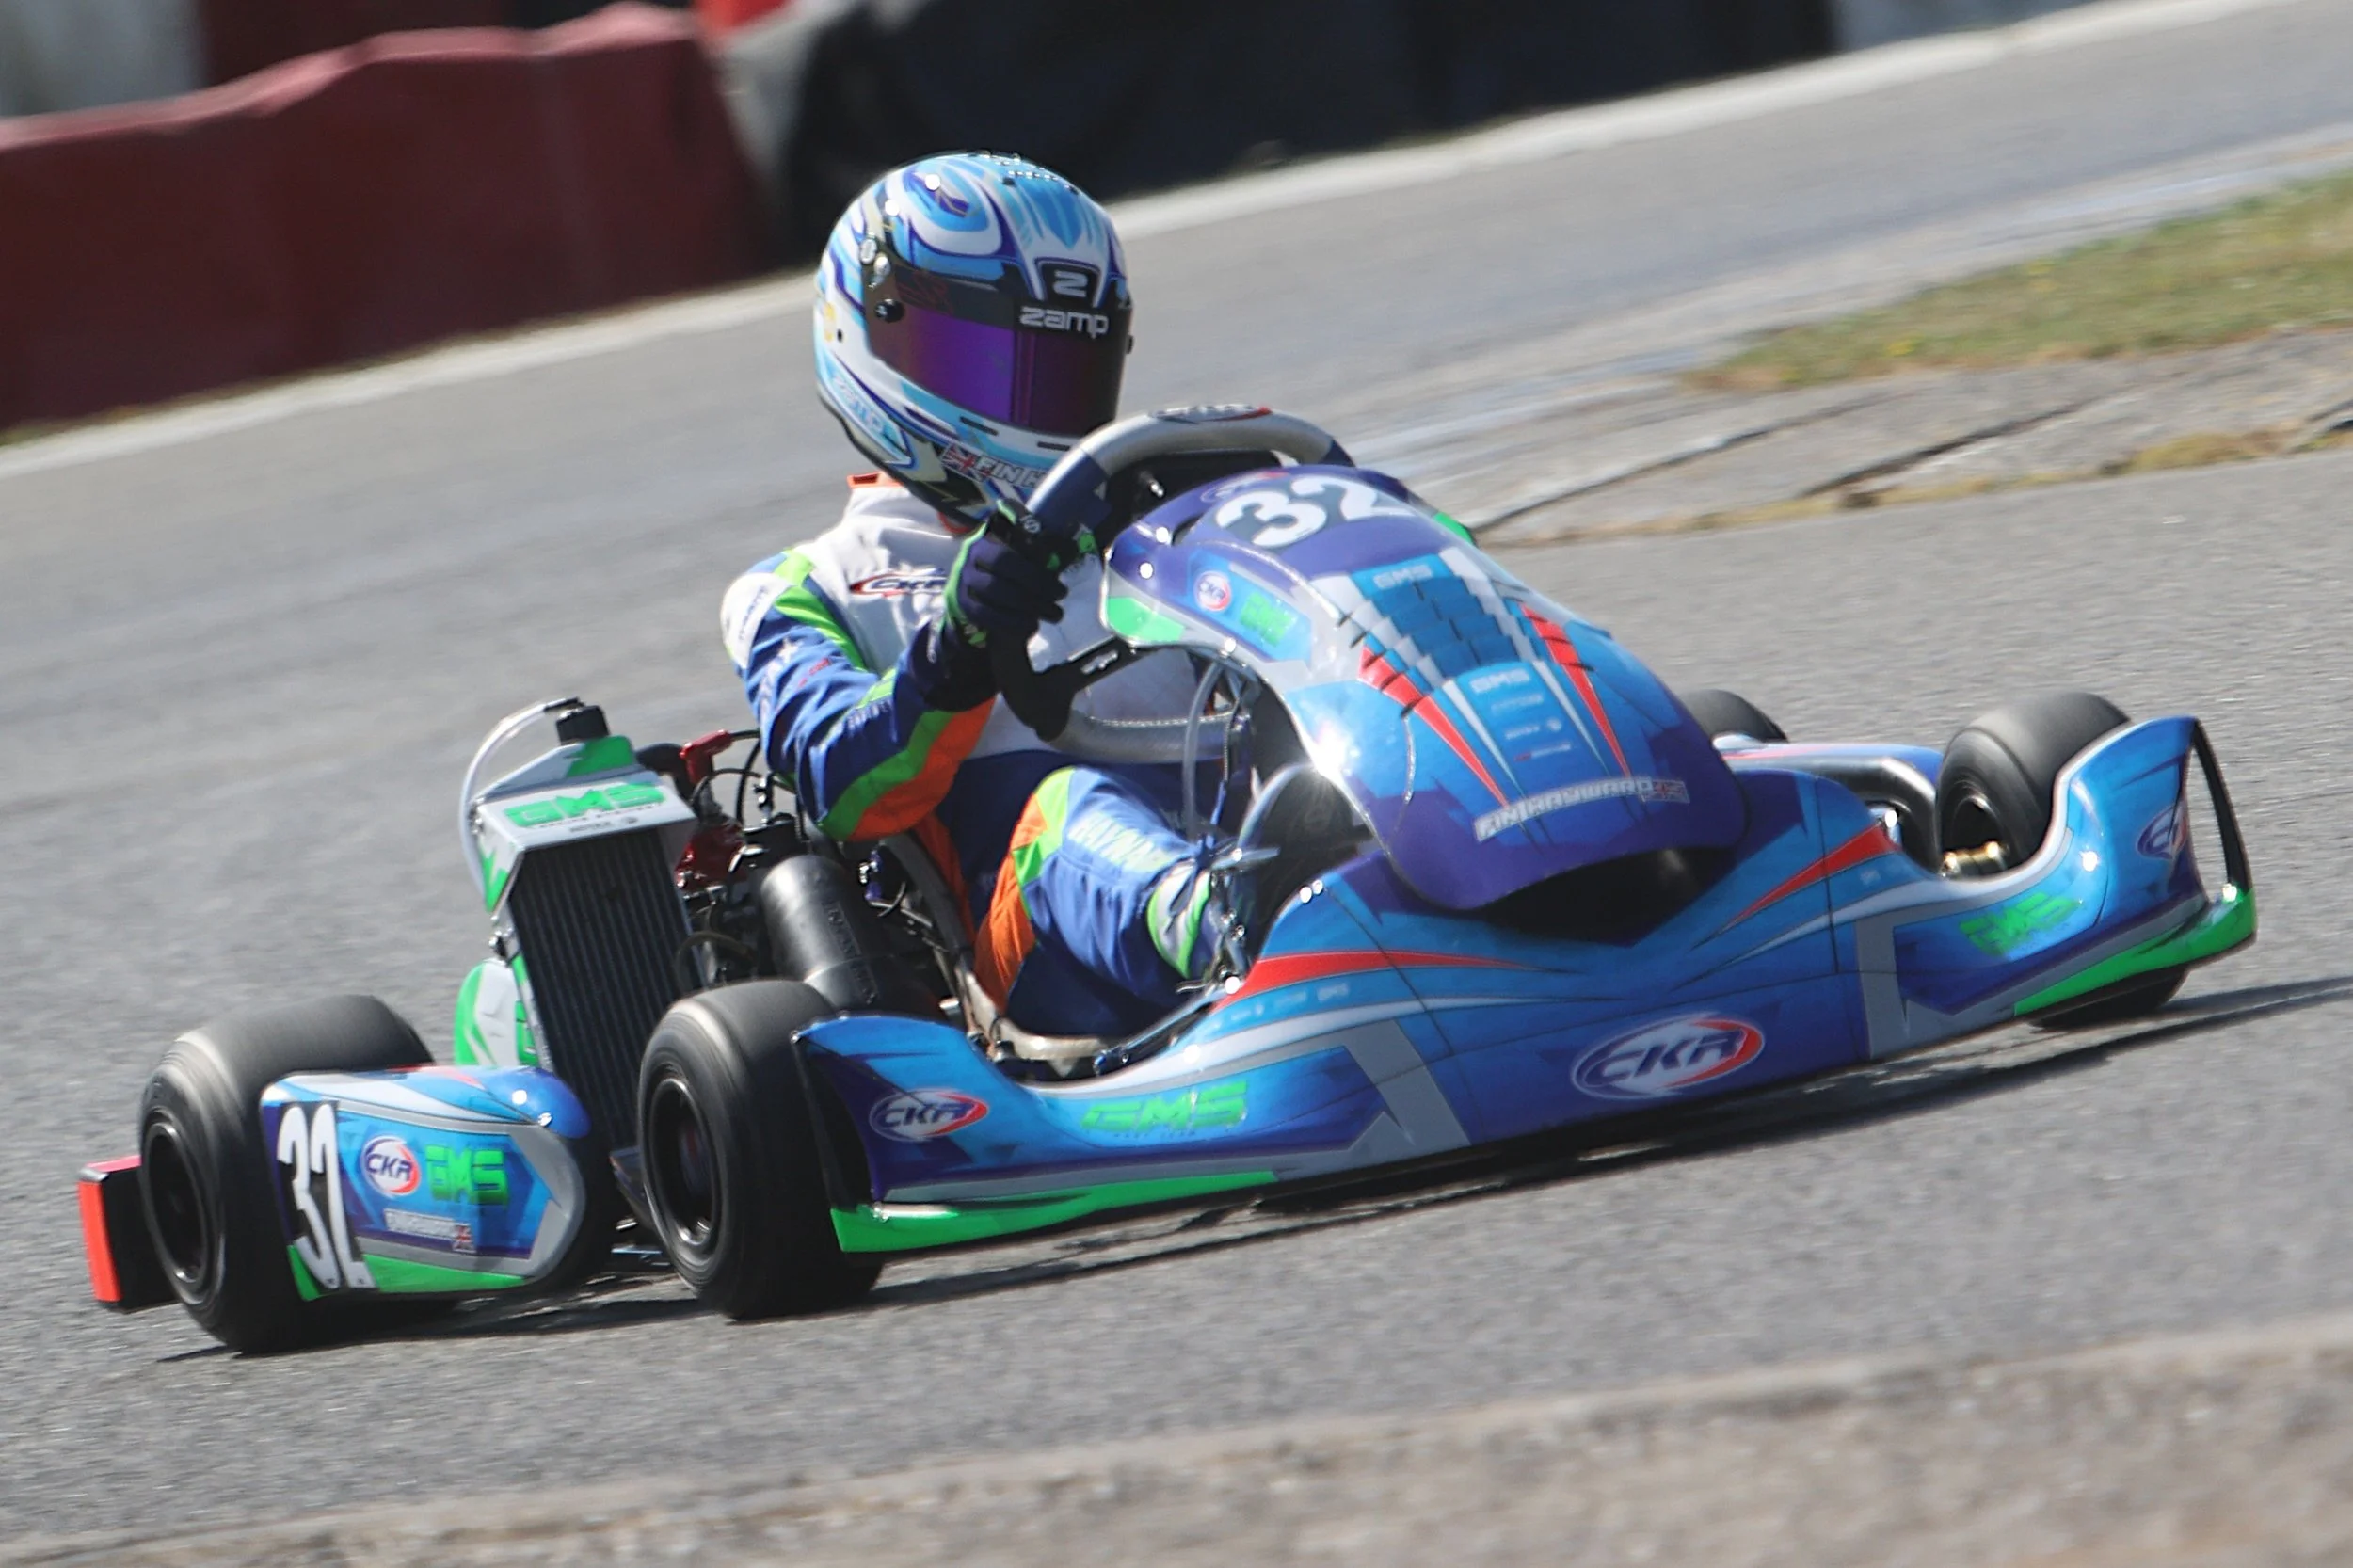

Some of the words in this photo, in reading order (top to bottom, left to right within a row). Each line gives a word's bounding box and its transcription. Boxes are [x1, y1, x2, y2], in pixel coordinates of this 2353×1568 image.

[1019, 305, 1109, 339] zamp
[1215, 473, 1419, 548] 32
[1583, 1029, 1748, 1087] CKR
[876, 1102, 976, 1128] CKR
[1080, 1080, 1248, 1133] GMS
[366, 1153, 412, 1183] CKR
[277, 1104, 376, 1289] 32
